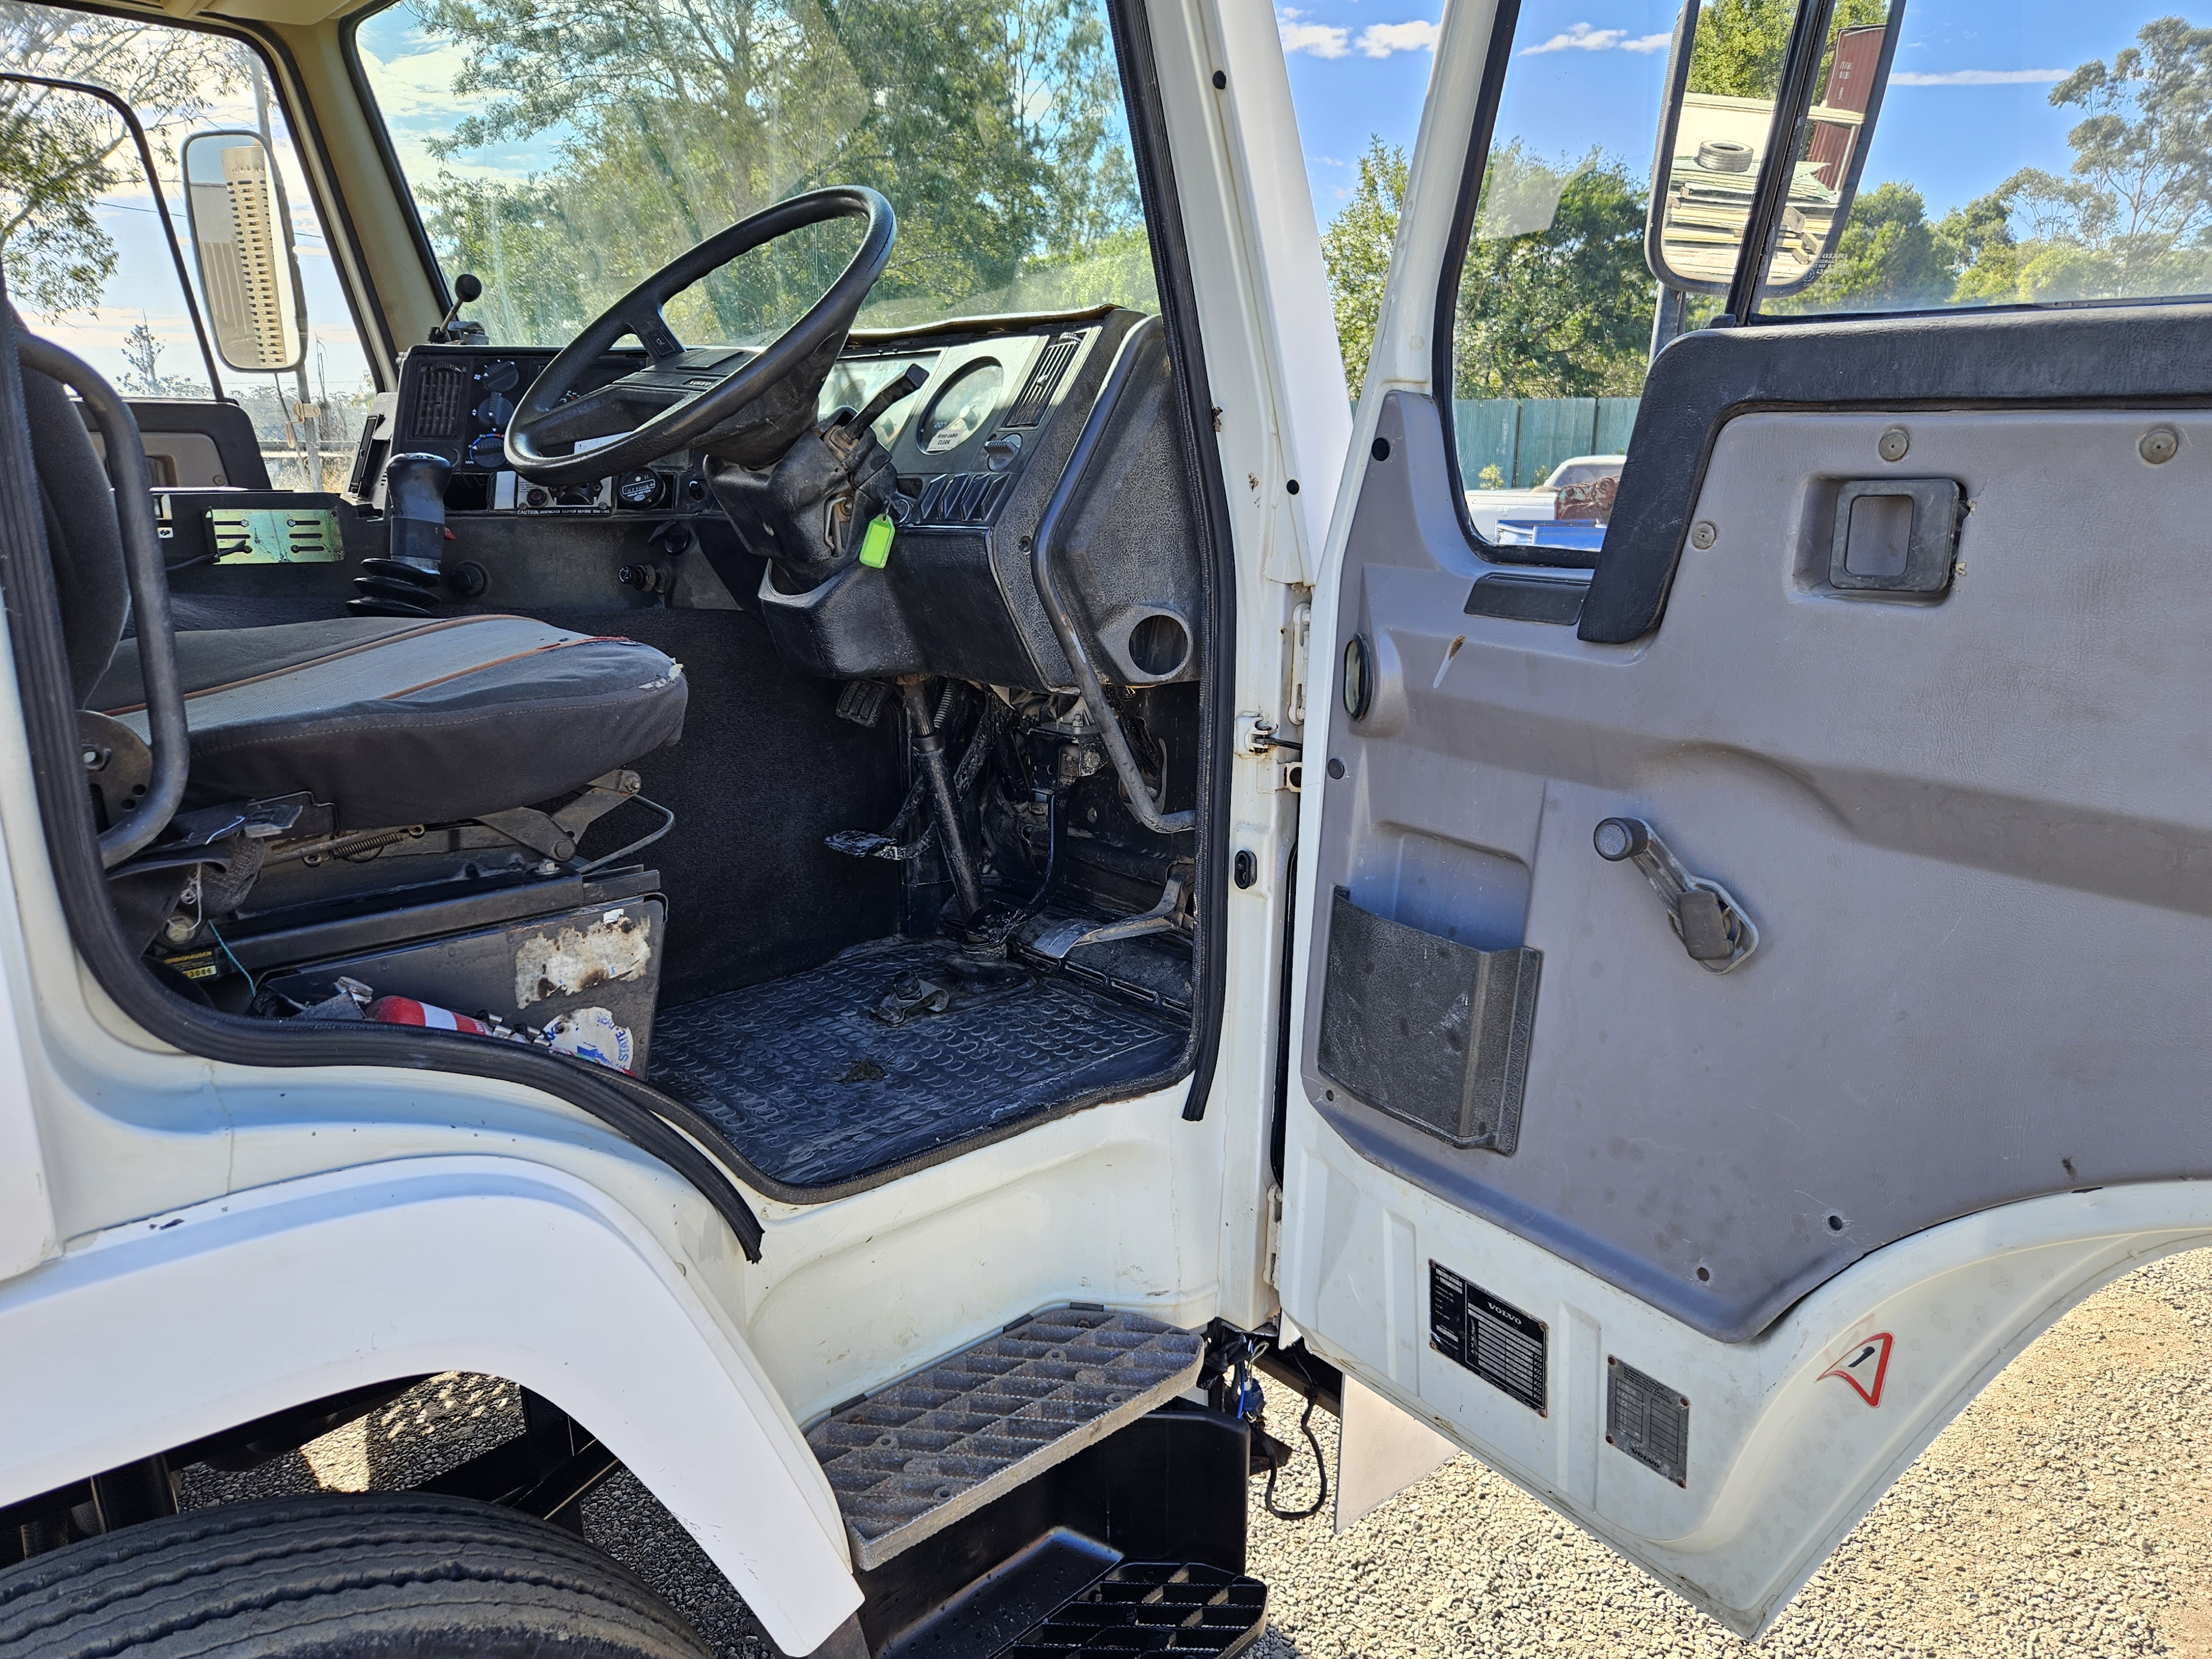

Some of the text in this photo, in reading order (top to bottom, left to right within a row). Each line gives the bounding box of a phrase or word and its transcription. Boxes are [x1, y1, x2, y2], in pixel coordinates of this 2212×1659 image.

[1487, 1301, 1522, 1325] VOLVO
[1534, 1360, 1542, 1369] KG
[1534, 1367, 1542, 1375] KG
[1534, 1374, 1542, 1382] KG
[1534, 1380, 1542, 1388] KG
[1534, 1386, 1542, 1395] KG
[1534, 1393, 1542, 1401] KG
[1631, 1447, 1660, 1468] VOLVO
